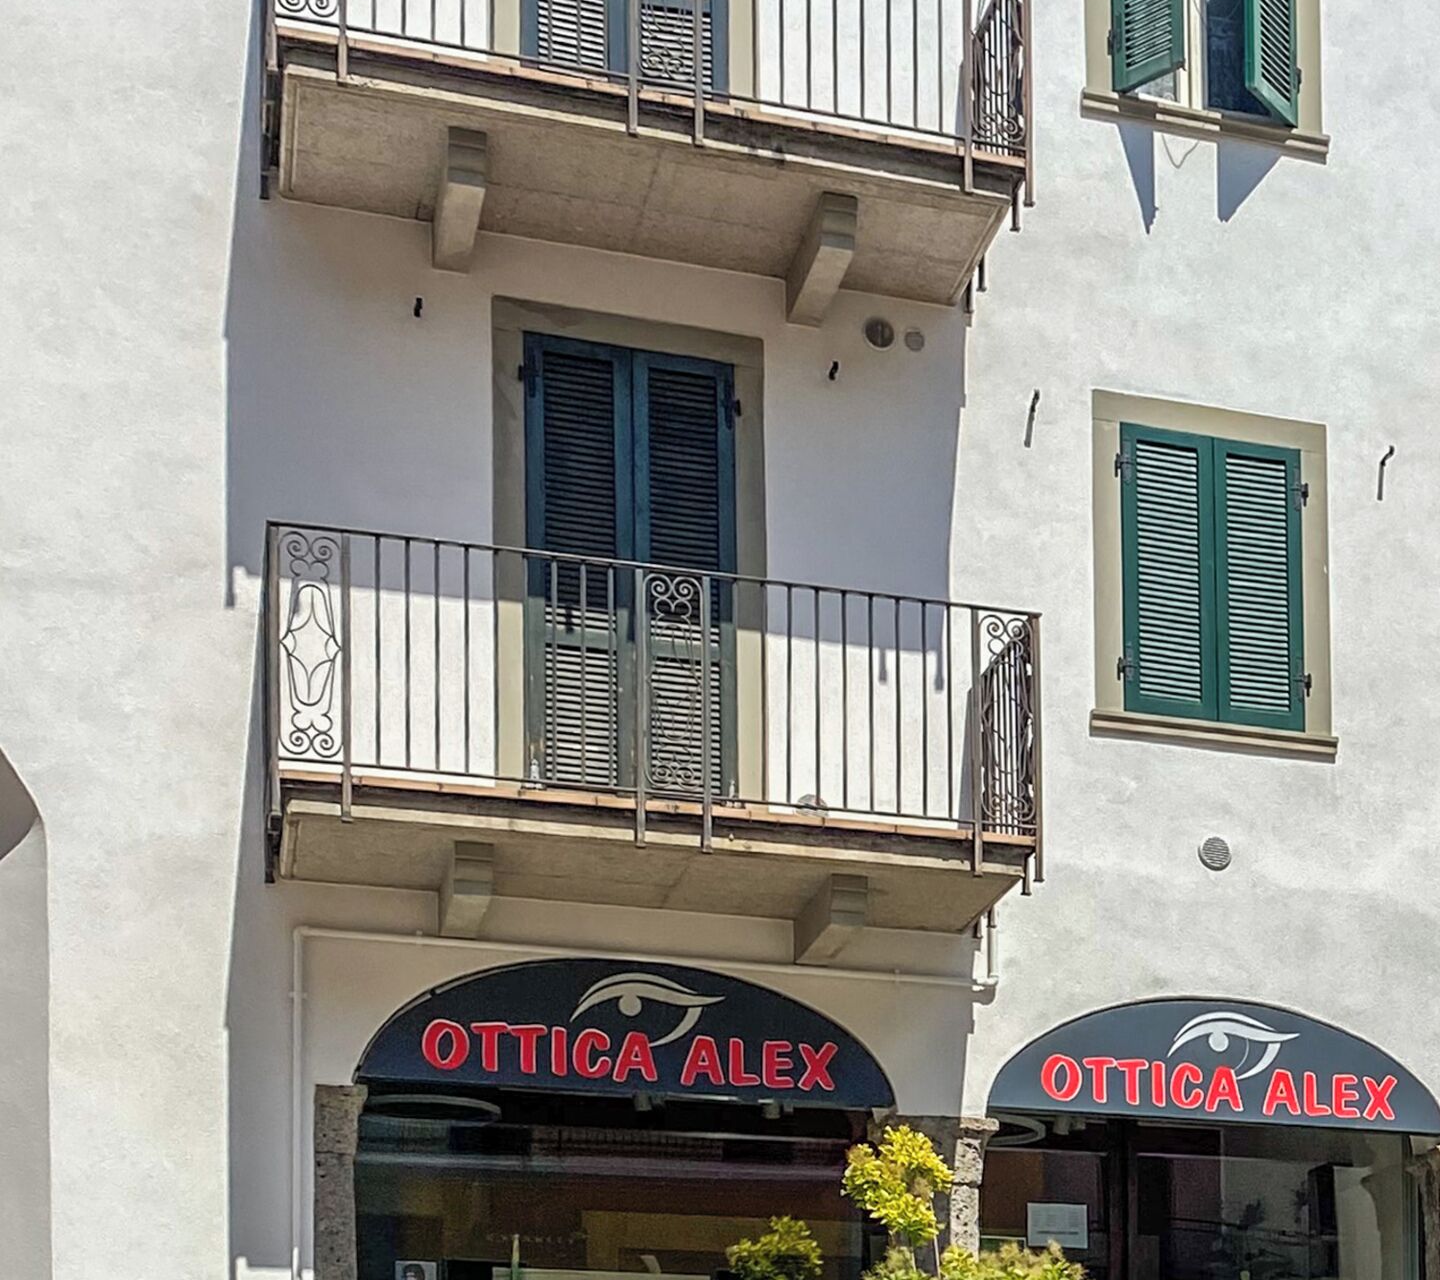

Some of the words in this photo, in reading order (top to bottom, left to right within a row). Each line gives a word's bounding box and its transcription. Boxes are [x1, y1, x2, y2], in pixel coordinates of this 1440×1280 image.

[421, 1018, 658, 1083] OTTICA
[679, 1034, 840, 1092] ALEX
[1040, 1053, 1244, 1113] OTTICA
[1262, 1068, 1399, 1121] ALEX
